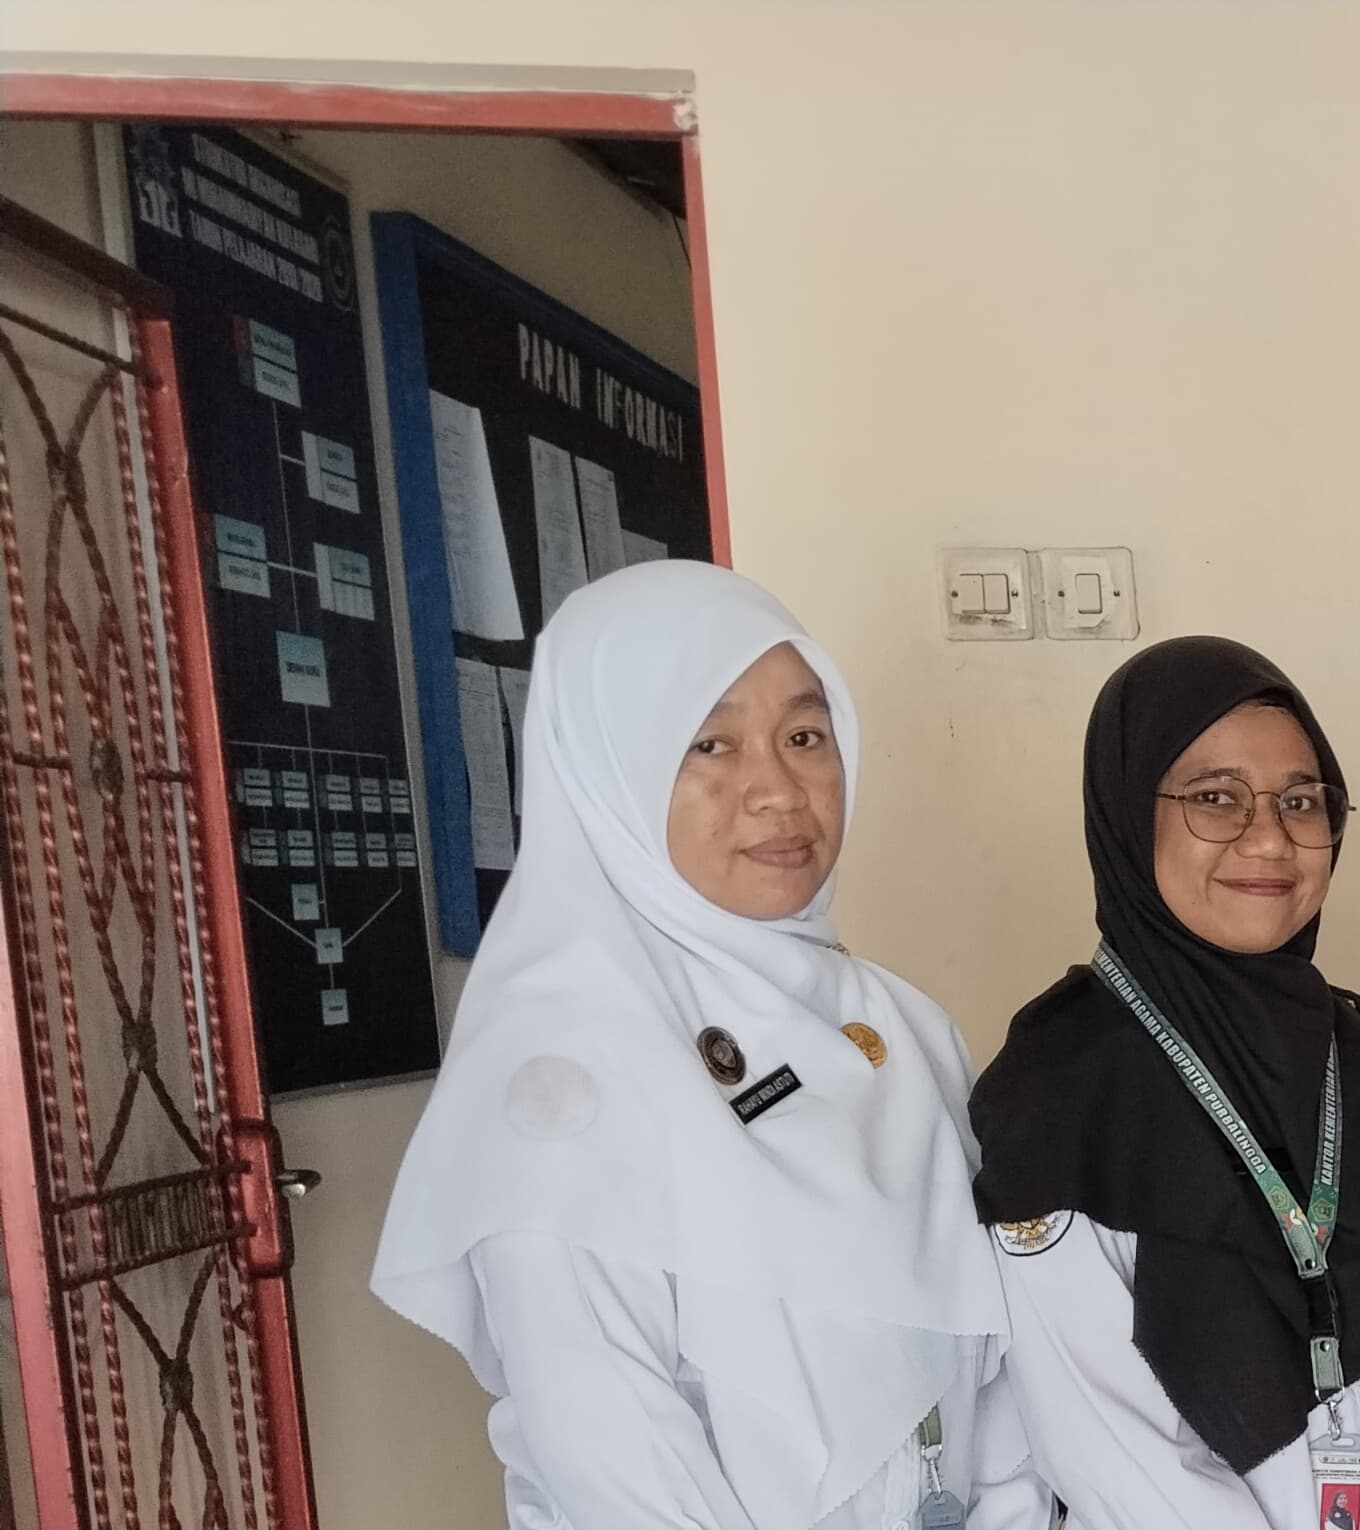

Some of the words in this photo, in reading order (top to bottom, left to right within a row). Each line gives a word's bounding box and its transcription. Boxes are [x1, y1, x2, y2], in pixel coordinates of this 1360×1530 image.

[518, 322, 581, 410] PAPAN
[596, 367, 684, 463] INFORMASI
[1155, 1031, 1211, 1094] KABUPATEN
[1321, 1140, 1335, 1185] KANTOR
